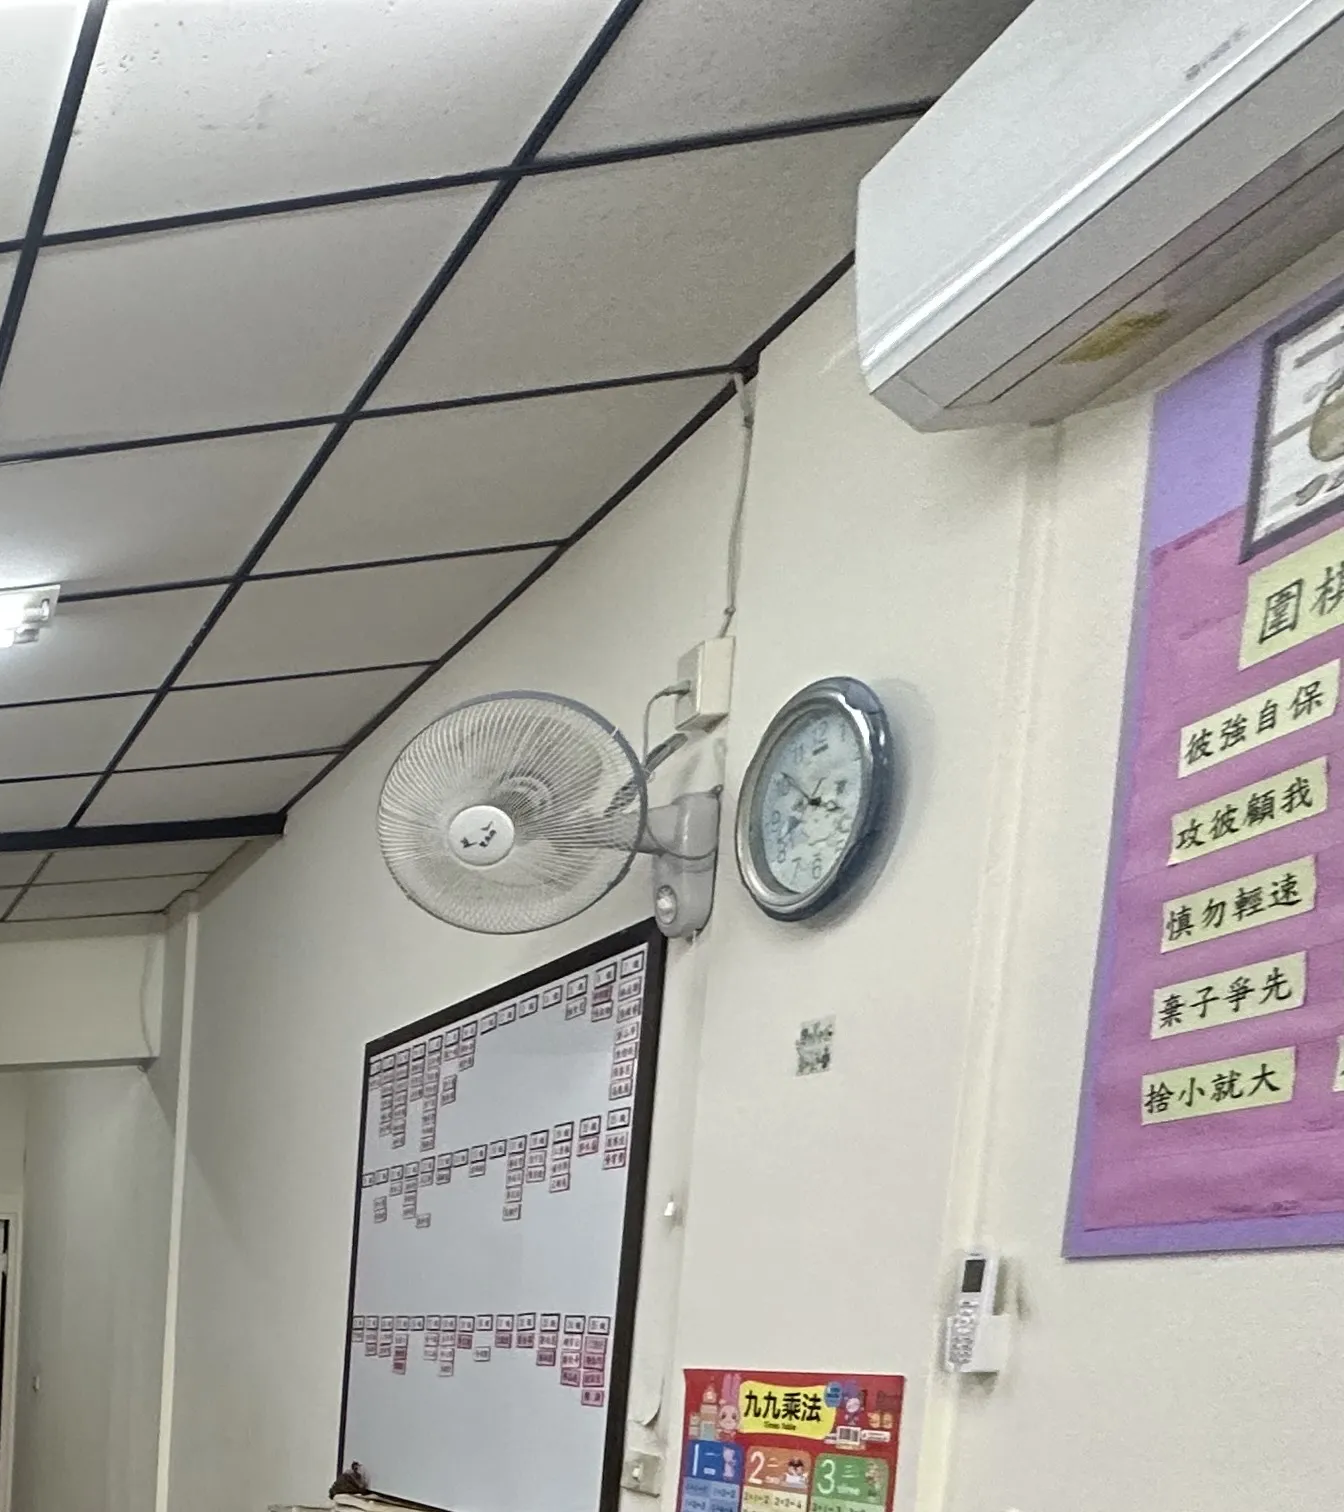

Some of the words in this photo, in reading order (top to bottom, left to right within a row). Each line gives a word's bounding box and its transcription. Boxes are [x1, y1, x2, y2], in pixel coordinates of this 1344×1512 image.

[1184, 681, 1324, 764] 彼強自保
[1175, 777, 1313, 849] 攻彼顧我
[1166, 873, 1302, 941] 慎勿輕速
[1159, 967, 1292, 1029] 棄子爭先
[1144, 1063, 1280, 1113] 捨小就大
[744, 1390, 821, 1422] 九九乘法
[692, 1444, 700, 1476] 1
[748, 1451, 765, 1484] 2
[817, 1459, 836, 1494] 3
